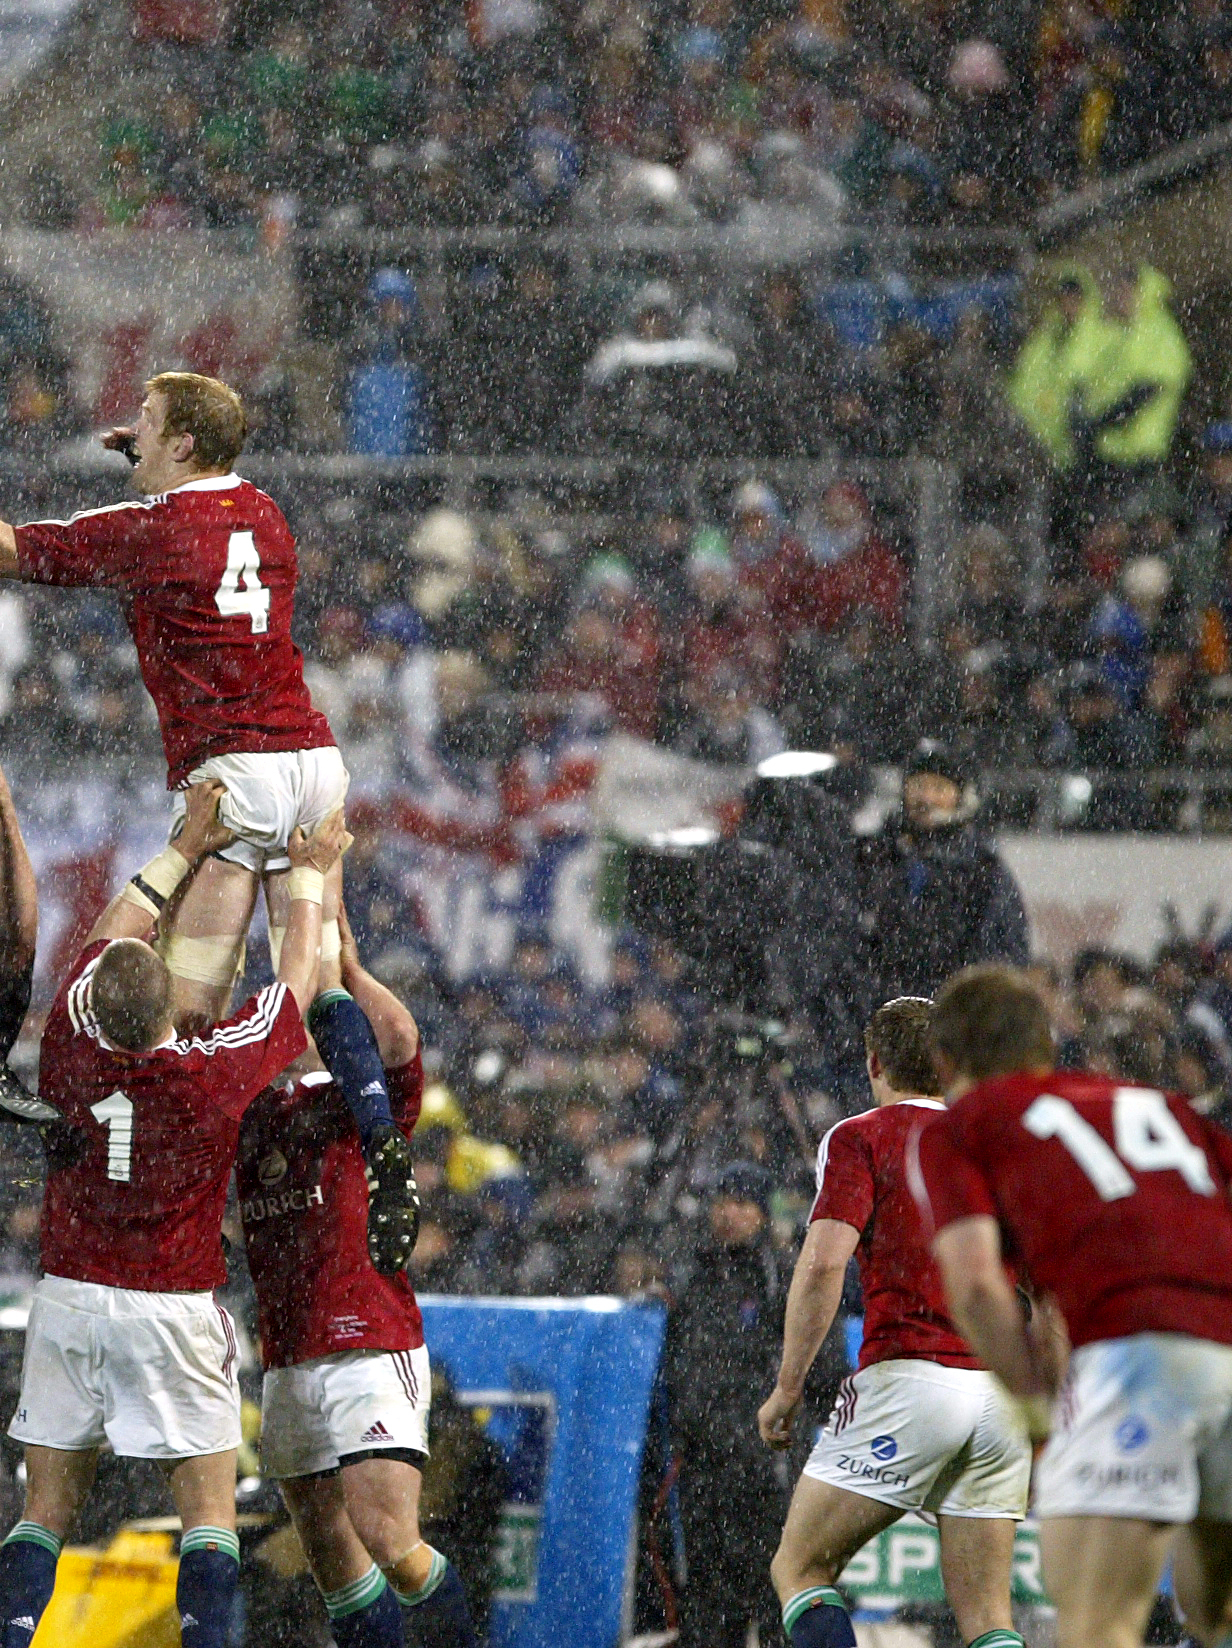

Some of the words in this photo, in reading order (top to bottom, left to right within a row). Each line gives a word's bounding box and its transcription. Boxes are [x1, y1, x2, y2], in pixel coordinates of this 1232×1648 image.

[214, 530, 270, 634] 4
[89, 1090, 134, 1182] 1
[1022, 1086, 1218, 1203] 14
[836, 1454, 911, 1488] ZURICH
